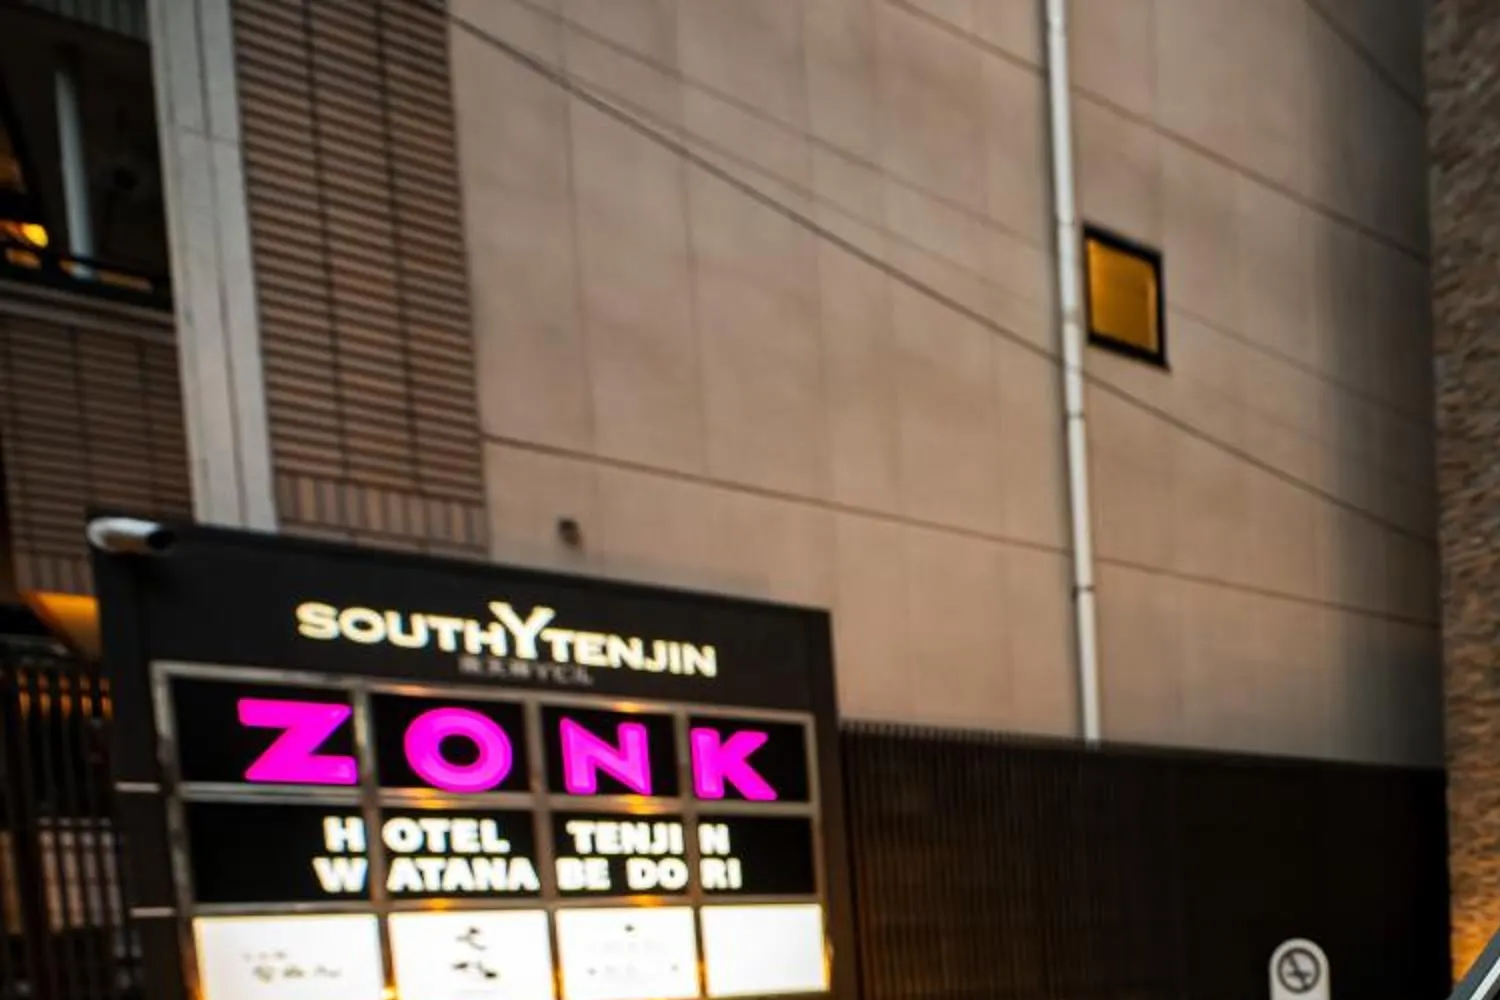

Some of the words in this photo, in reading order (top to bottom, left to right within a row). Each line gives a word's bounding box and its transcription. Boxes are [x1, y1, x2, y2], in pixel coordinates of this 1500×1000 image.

[237, 698, 777, 801] ZONK
[324, 816, 511, 854] HOTEL
[566, 820, 731, 855] TENJIN
